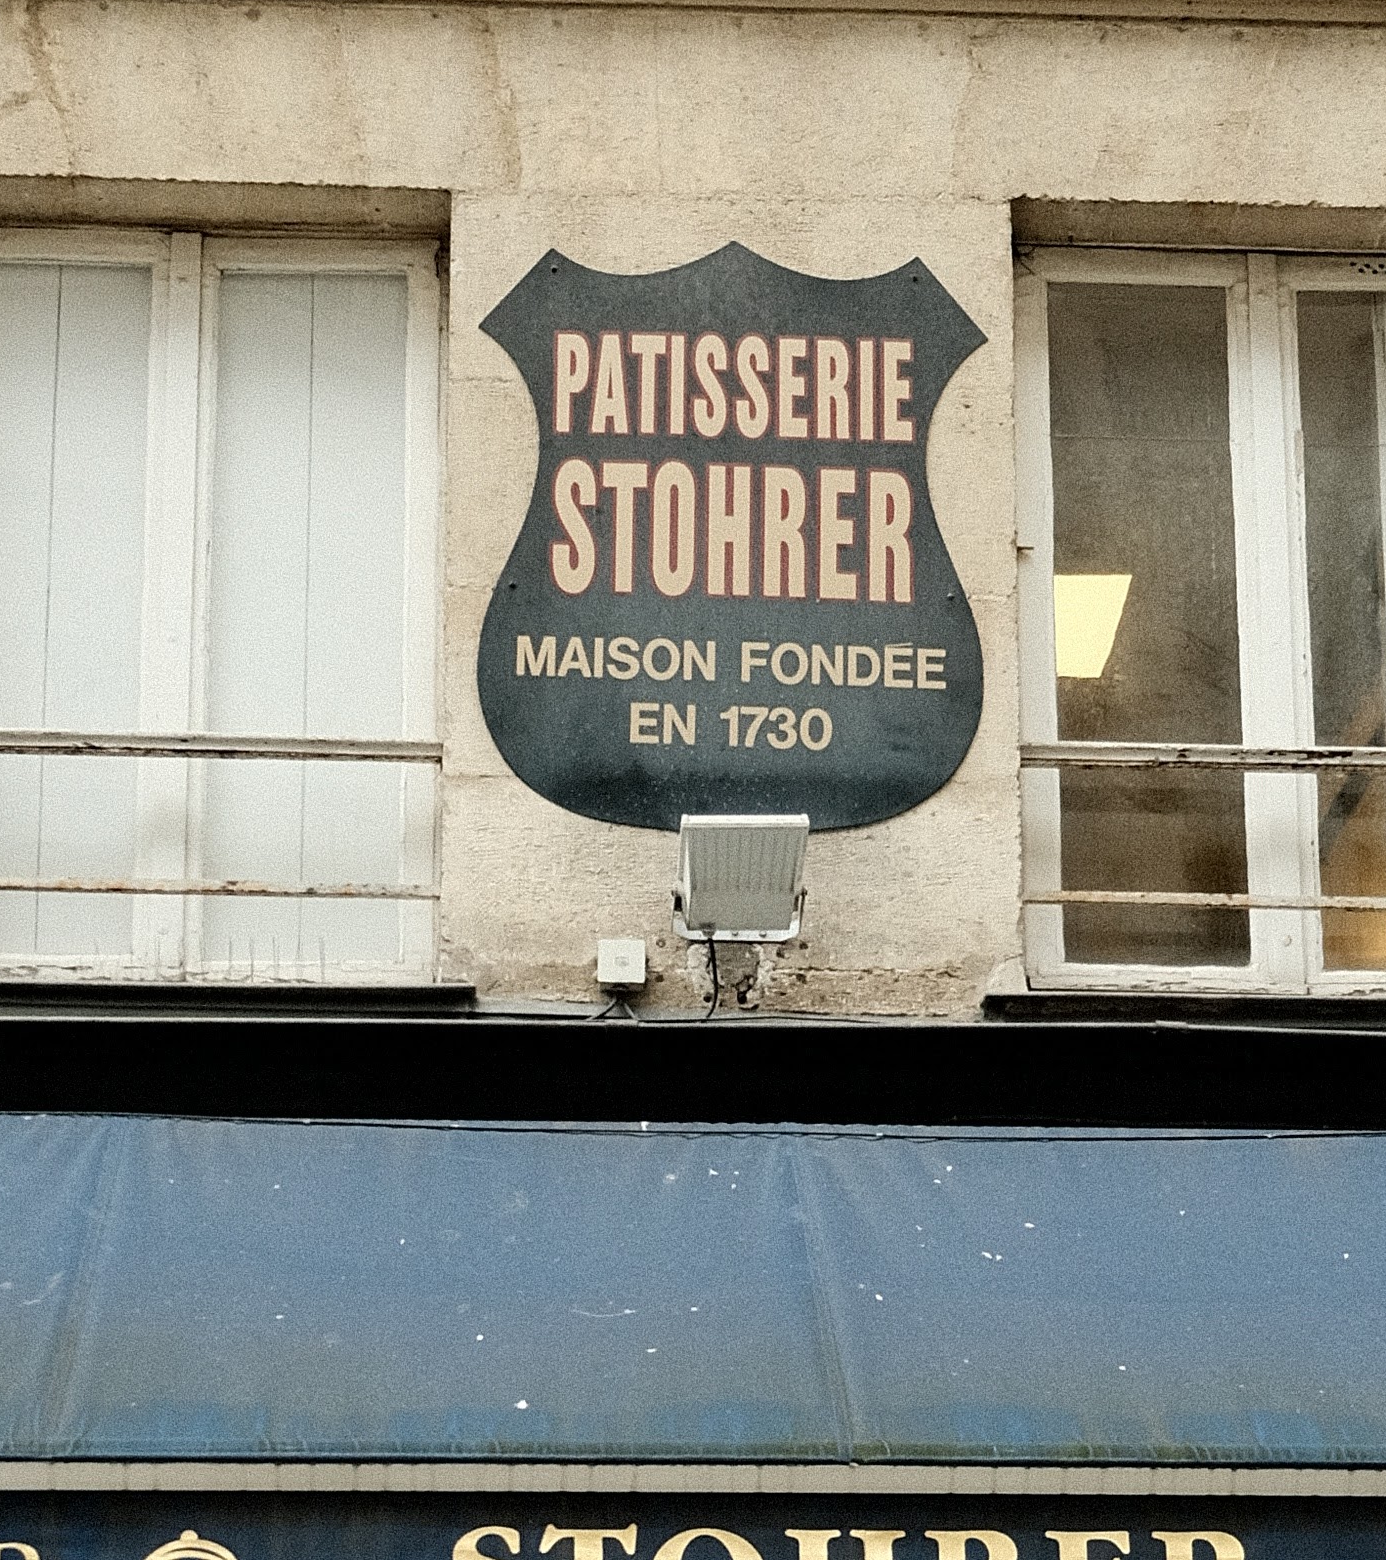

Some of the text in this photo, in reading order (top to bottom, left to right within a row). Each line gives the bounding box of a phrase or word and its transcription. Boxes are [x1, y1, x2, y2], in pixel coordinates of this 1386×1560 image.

[552, 329, 915, 442] PATISSERIE
[550, 457, 915, 605] STOHRER
[516, 635, 947, 690] MAISON FONDÉE
[629, 702, 834, 751] EN 1730
